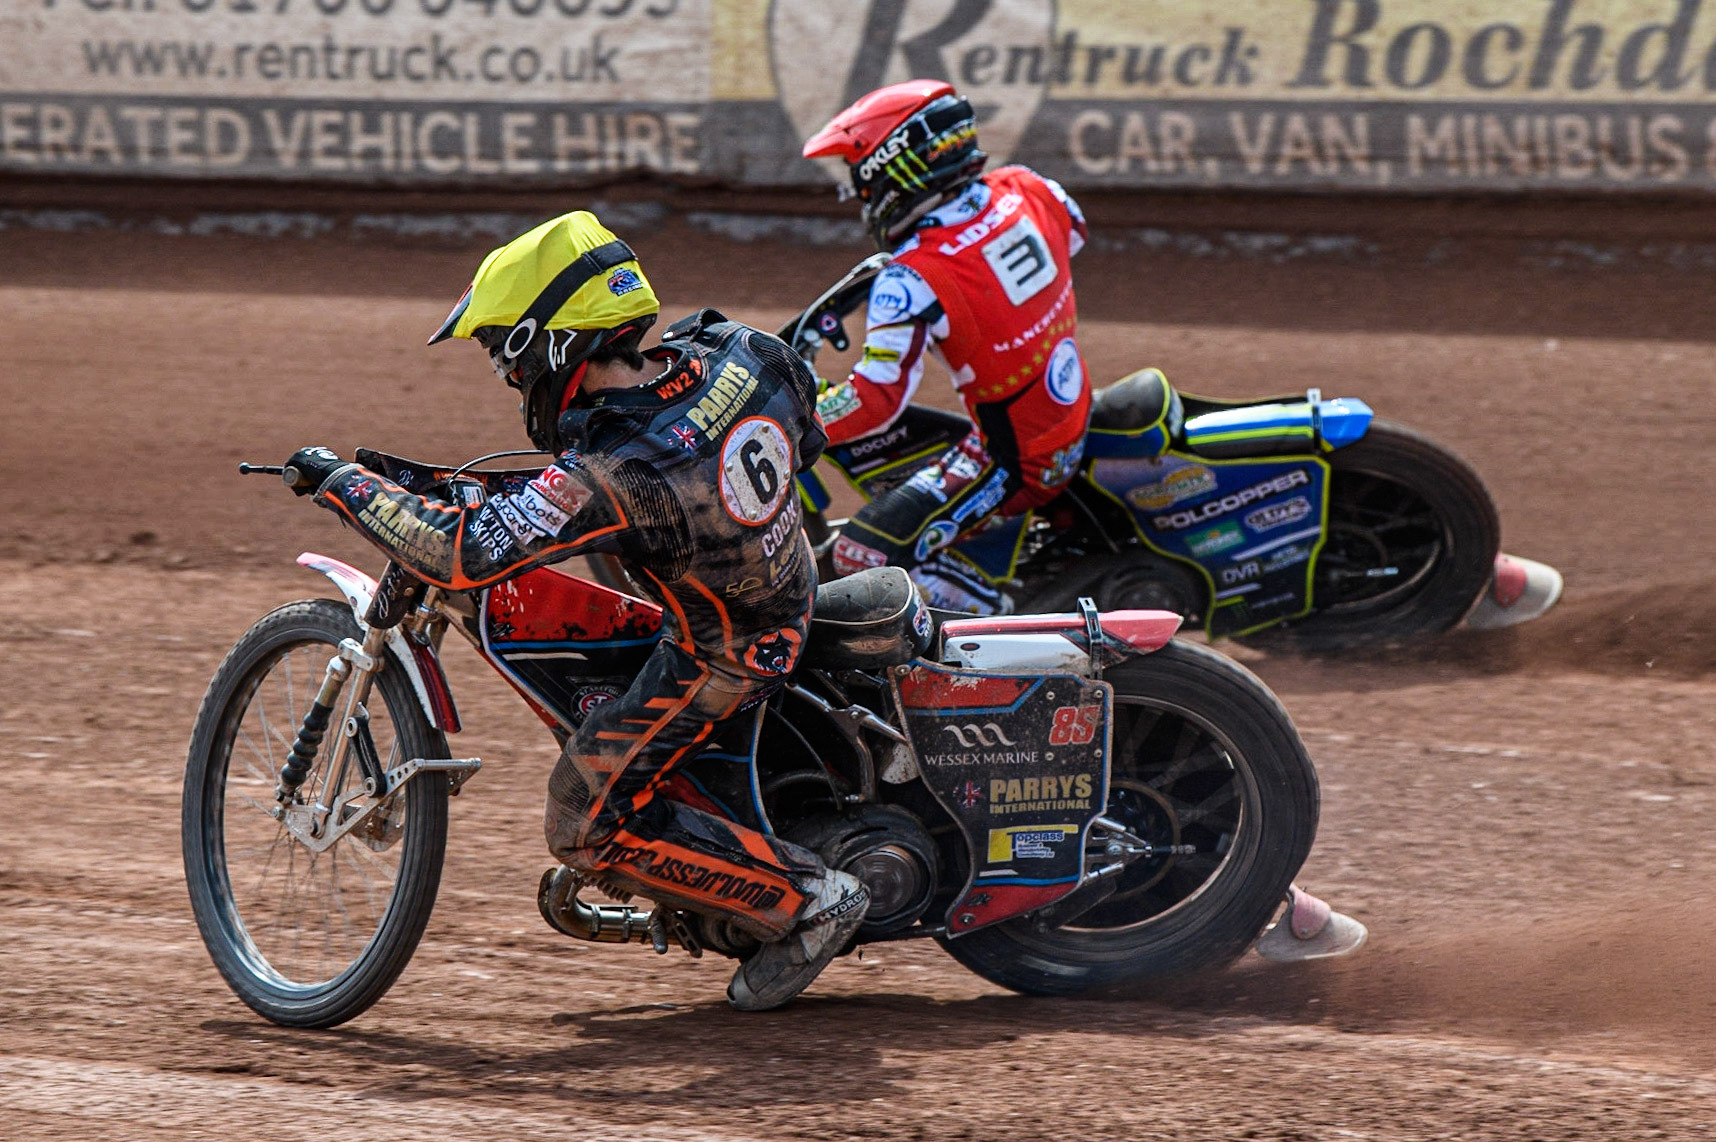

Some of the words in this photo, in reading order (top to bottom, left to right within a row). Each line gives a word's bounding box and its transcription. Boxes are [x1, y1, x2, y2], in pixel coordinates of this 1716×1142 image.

[82, 33, 622, 84] www.rentruck.co.uk
[1286, 0, 1716, 91] Rochd
[264, 110, 538, 173] VEHICLE
[554, 114, 700, 173] HIRE
[1068, 110, 1218, 180] CAR,
[1229, 112, 1392, 185] VAN,
[1408, 114, 1691, 182] MINIBUS
[1000, 235, 1047, 287] 3
[656, 372, 694, 400] WV2
[686, 361, 750, 431] PARRYS
[704, 376, 759, 441] INTERNATIONAL
[740, 439, 779, 505] 6
[469, 519, 503, 561] SKIPS
[1049, 705, 1100, 746] 85
[924, 752, 982, 766] WESSEX
[983, 751, 1039, 765] MARINE
[989, 773, 1093, 803] PARRYS
[989, 798, 1092, 815] INTERNATIONAL
